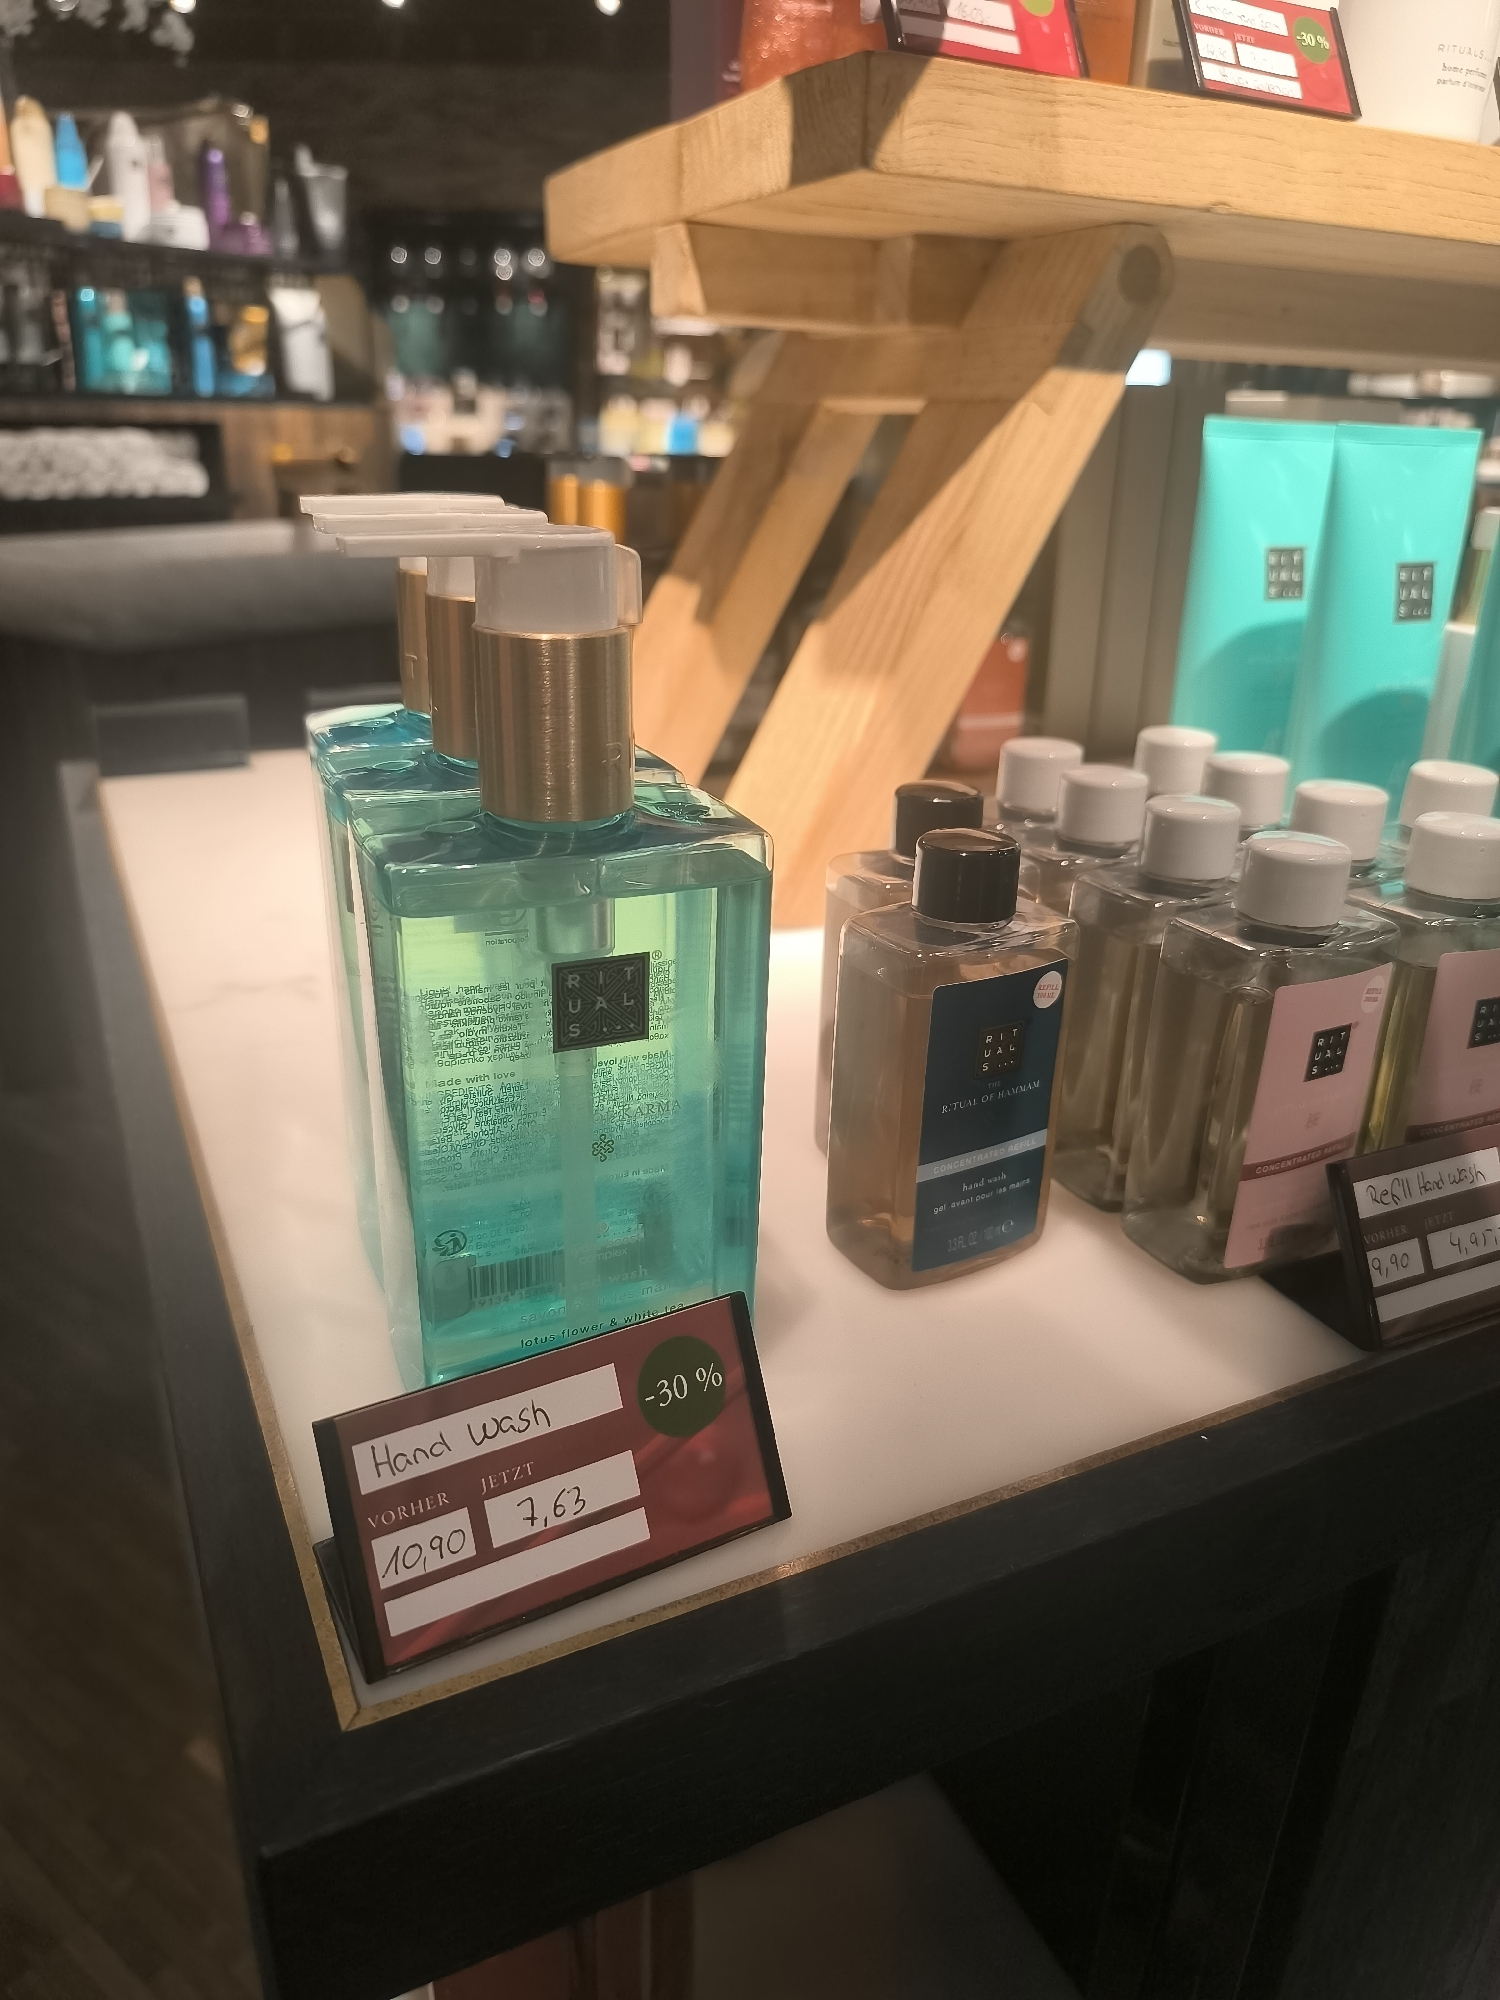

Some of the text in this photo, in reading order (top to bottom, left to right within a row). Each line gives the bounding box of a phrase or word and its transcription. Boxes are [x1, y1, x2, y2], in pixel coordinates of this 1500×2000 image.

[1296, 32, 1330, 50] -30 %
[493, 1071, 516, 1080] love
[622, 1099, 682, 1119] KARMA
[941, 1079, 1041, 1114] RITUAL OF HAMMAM
[933, 1138, 1037, 1175] CONCENTRATED REFILL
[1255, 1150, 1322, 1175] CONCENTRATED
[962, 1177, 985, 1192] hand
[933, 1204, 946, 1215] gel
[975, 1190, 994, 1203] pour
[1363, 1210, 1455, 1245] VORHER JETZT
[1371, 1252, 1410, 1279] 9,90
[520, 1331, 556, 1350] lotus
[561, 1321, 605, 1340] flower
[609, 1317, 619, 1327] &
[623, 1308, 661, 1326] white
[644, 1362, 724, 1409] -30 %
[370, 1431, 453, 1479] Hand
[367, 1460, 535, 1530] VORHER JETZT
[381, 1485, 588, 1580] 10,90 7,63
